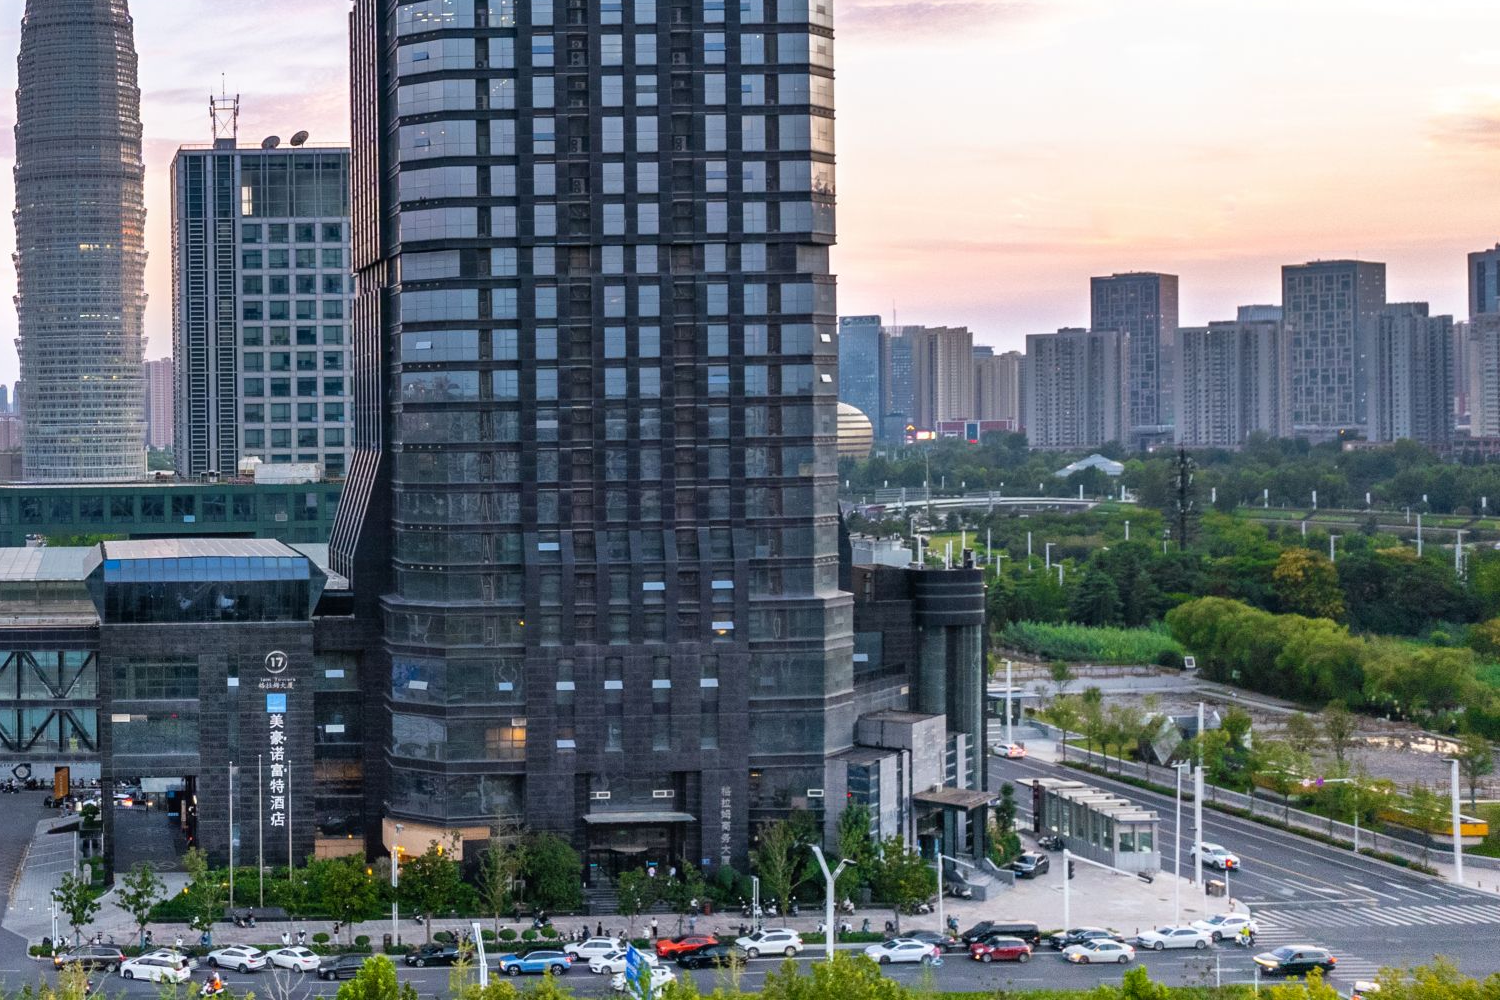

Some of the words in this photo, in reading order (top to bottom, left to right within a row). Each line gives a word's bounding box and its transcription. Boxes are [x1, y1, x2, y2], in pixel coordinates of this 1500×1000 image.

[270, 657, 283, 667] 17
[269, 713, 285, 827] 美豪诺富特酒店
[721, 785, 732, 866] 格拉姆商务大厦
